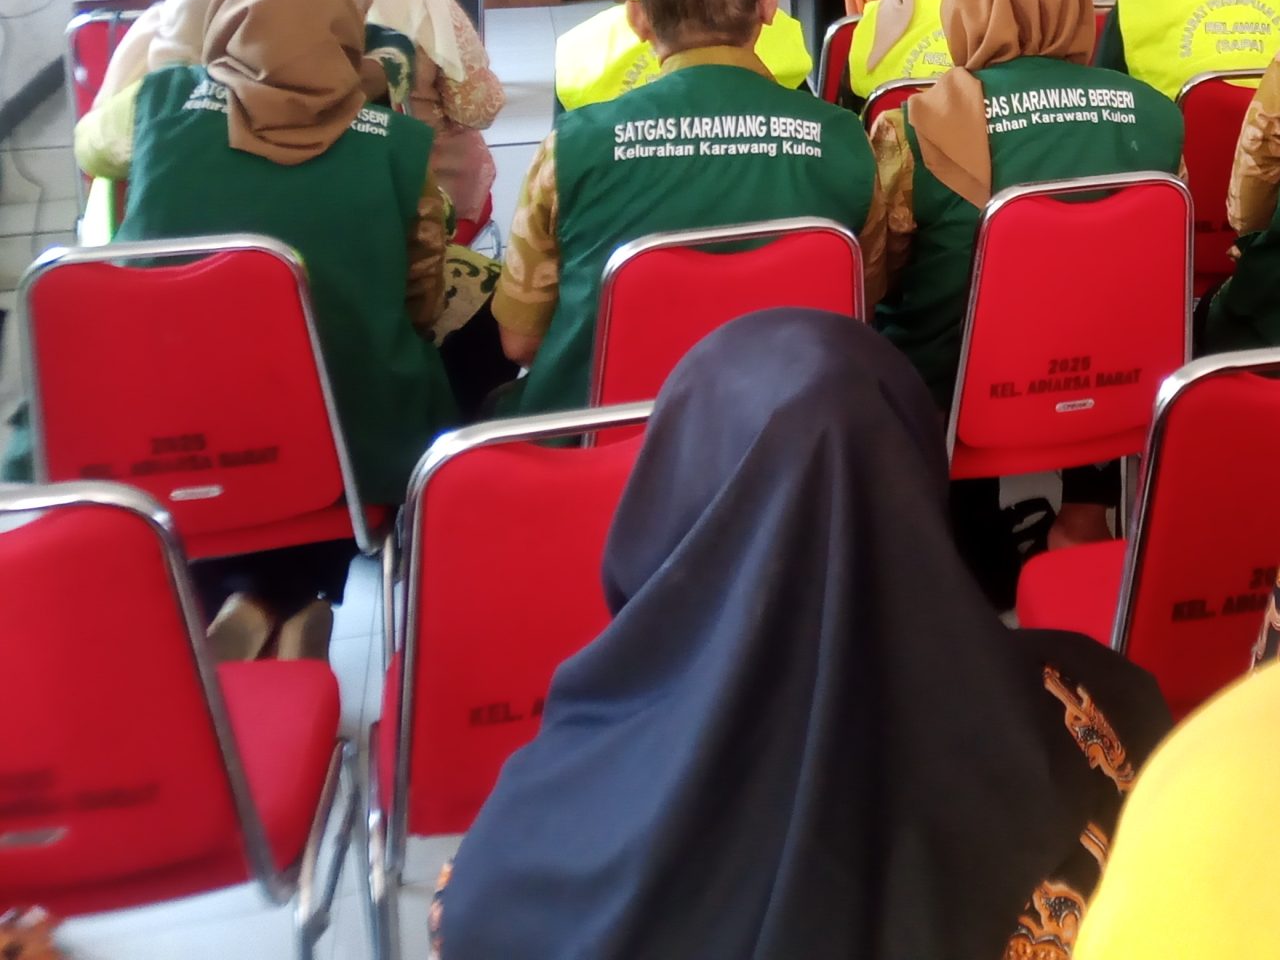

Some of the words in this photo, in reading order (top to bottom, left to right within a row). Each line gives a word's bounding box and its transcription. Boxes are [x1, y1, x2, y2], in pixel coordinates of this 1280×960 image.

[984, 96, 1010, 119] GAS
[1011, 88, 1086, 114] KARAWANG
[1088, 89, 1135, 109] BERSERI
[357, 109, 389, 127] SERI
[1031, 110, 1098, 125] Karawang
[1101, 109, 1136, 124] Kulon
[614, 118, 677, 144] SATGAS
[680, 115, 767, 139] KARAWANG
[770, 116, 822, 143] BERSERI
[614, 143, 694, 161] Kelurahan
[699, 141, 777, 157] Karawang
[782, 140, 822, 157] Kulon
[989, 381, 1022, 399] KEL.
